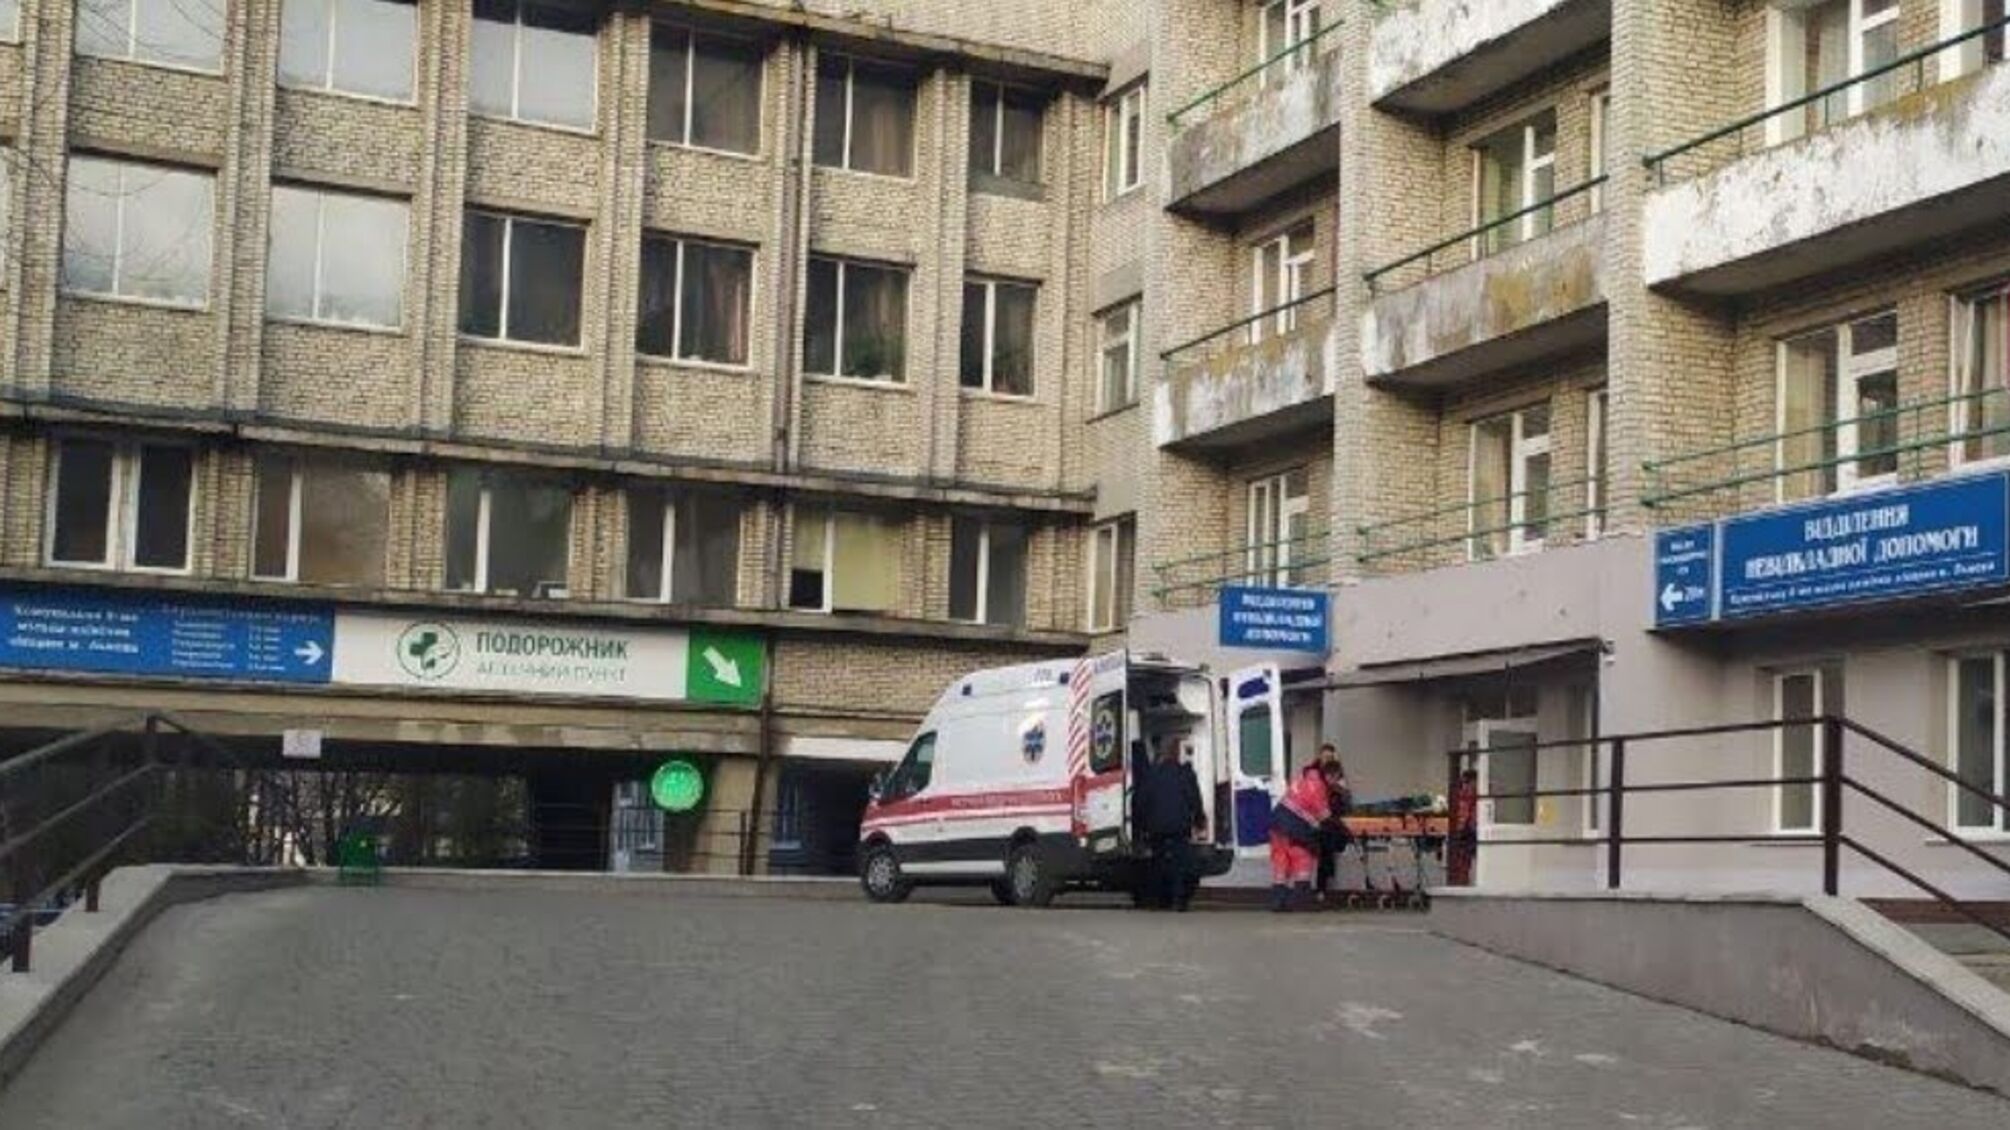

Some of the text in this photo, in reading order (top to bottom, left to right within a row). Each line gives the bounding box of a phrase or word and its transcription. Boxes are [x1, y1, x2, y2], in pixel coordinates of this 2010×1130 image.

[1804, 504, 1909, 542] ВІДДІЛЕННЯ
[1744, 525, 1979, 579] НЕВІДКЛАДНОЇ ДОПОМОГИ
[476, 631, 629, 660] ПОДОРОЖНИК
